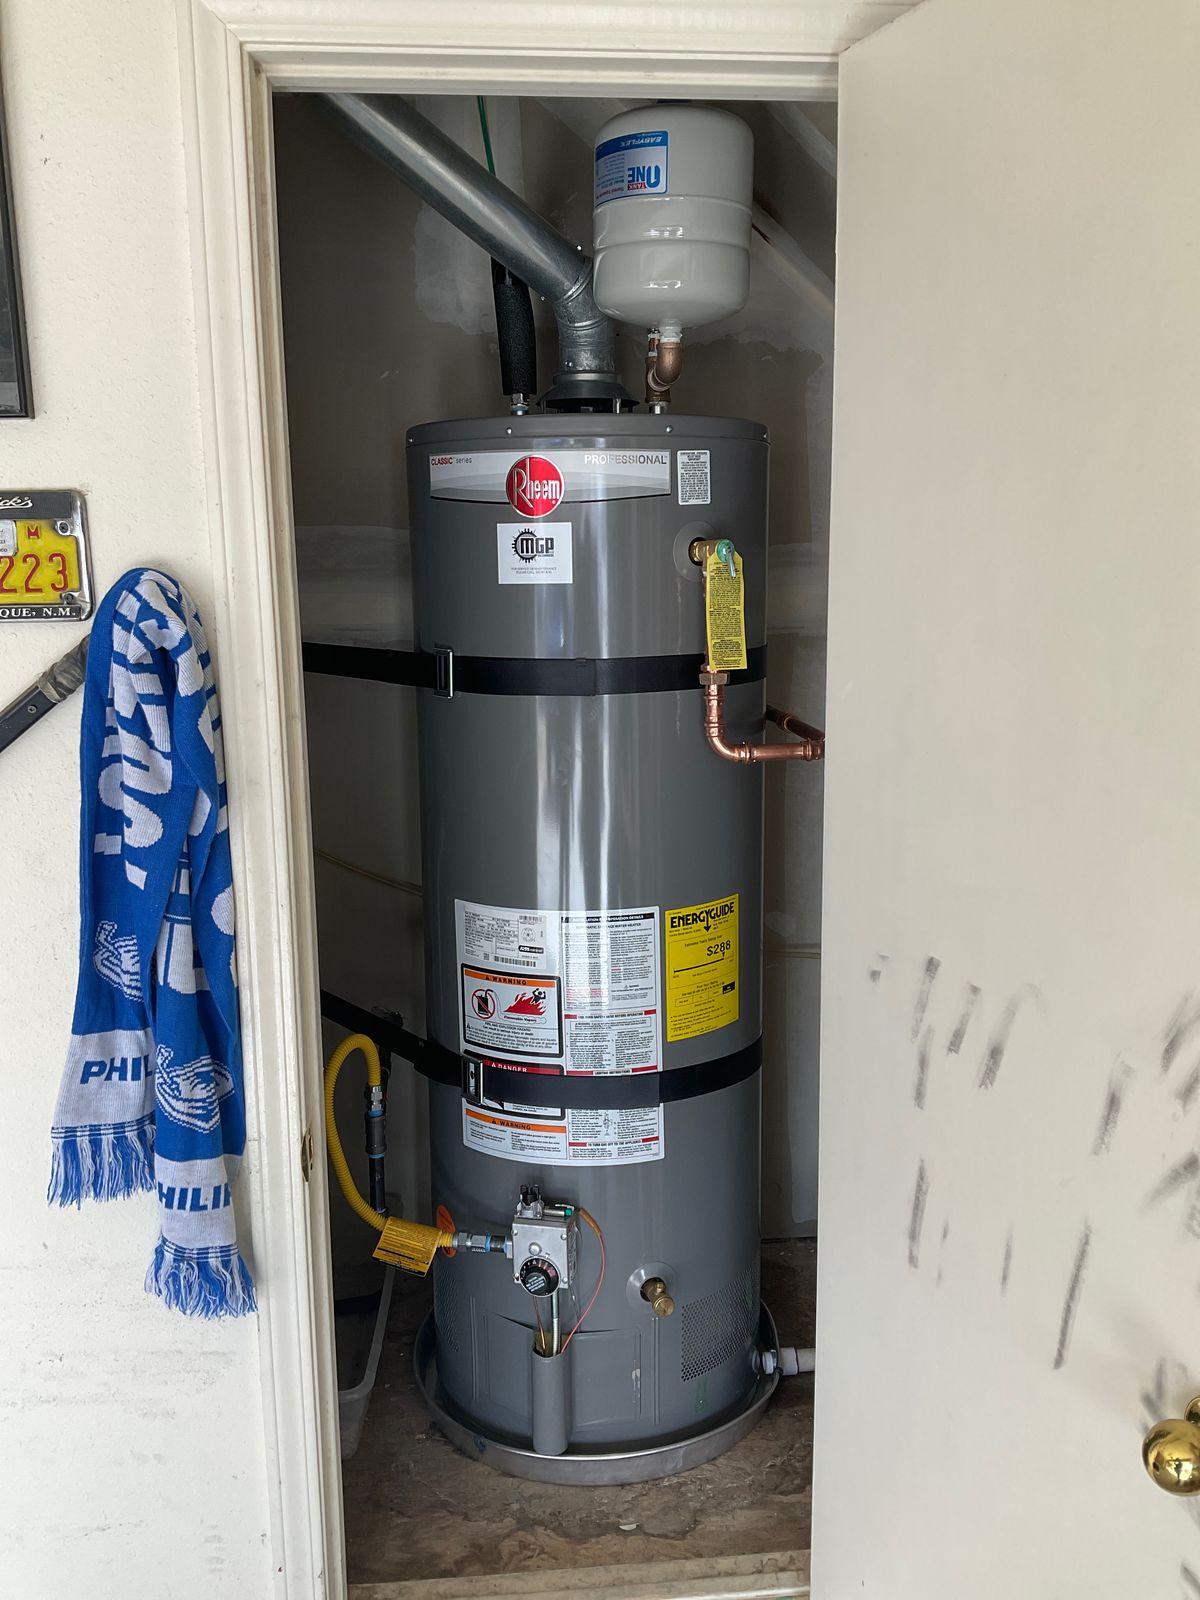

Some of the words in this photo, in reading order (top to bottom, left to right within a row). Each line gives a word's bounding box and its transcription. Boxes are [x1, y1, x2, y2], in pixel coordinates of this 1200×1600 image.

[627, 164, 661, 189] ONE
[629, 182, 647, 190] TANK
[431, 457, 453, 466] CLASSIC
[584, 454, 668, 465] PROFESSIONAL
[513, 457, 561, 508] Rheem
[520, 537, 555, 554] MGP
[0, 553, 69, 593] 223
[43, 607, 76, 616] N.M.
[670, 901, 735, 930] ENERGYGUIDE
[492, 976, 527, 986] WARNING
[500, 1121, 531, 1130] WARNING
